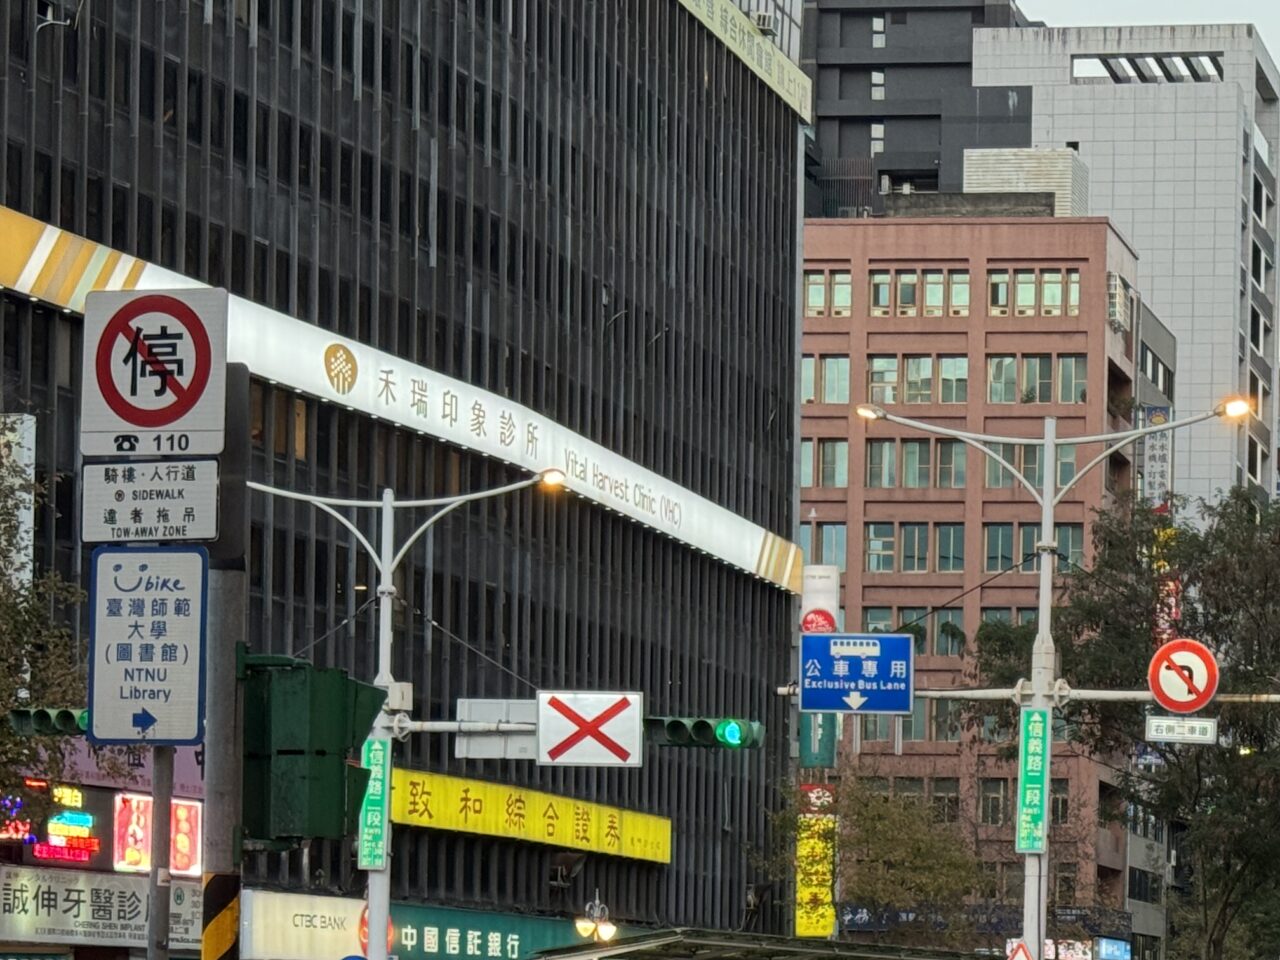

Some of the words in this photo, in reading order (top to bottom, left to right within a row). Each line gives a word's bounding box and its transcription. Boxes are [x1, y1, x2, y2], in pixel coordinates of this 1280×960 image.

[122, 325, 184, 397] 停
[377, 368, 539, 461] 禾瑞印象診所
[152, 434, 190, 452] 110
[132, 488, 185, 501] SIDEWALK
[564, 447, 588, 482] Vital
[592, 462, 630, 503] Harvest
[633, 482, 656, 515] Clinic
[659, 493, 683, 529] (VHC)
[103, 507, 196, 525] 違者拖吊
[111, 527, 160, 538] TOW-AWAY
[162, 525, 188, 537] ZONE
[106, 598, 191, 618] 臺灣師範
[127, 620, 168, 640] 大學
[104, 642, 189, 665] (圖書館)
[124, 668, 168, 682] NTNU
[805, 659, 907, 679] 公車專用
[119, 686, 171, 702] Library
[804, 678, 856, 690] Exclusive
[858, 679, 878, 690] Bus
[880, 680, 906, 690] Lane
[408, 780, 621, 847] 致和綜合證券
[2, 882, 150, 924] 誠伸牙醫診
[292, 913, 318, 928] CTBC
[319, 915, 347, 932] BANK
[401, 924, 521, 960] 中國信託銀行
